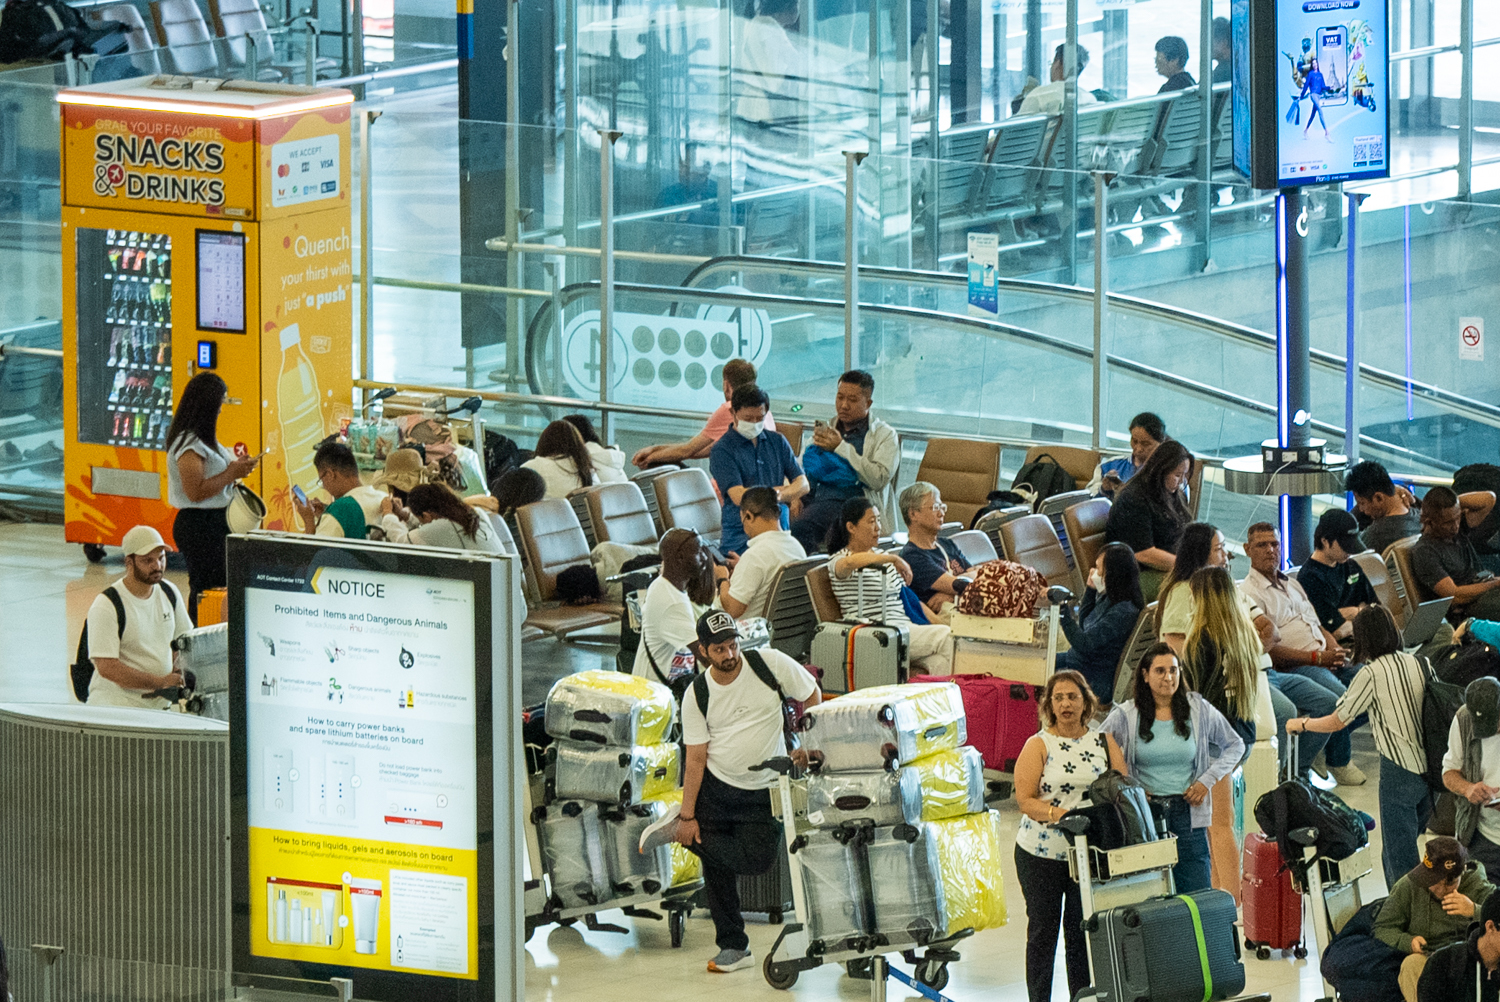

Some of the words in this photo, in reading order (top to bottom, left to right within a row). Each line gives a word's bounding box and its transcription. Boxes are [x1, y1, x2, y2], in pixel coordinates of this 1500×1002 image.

[95, 119, 128, 132] GRAB
[130, 121, 163, 135] YOUR
[164, 125, 222, 140] FAVORITE
[95, 133, 224, 172] SNACKS
[289, 150, 298, 158] WE
[300, 146, 322, 157] ACCEPT
[320, 159, 334, 169] VISA
[94, 164, 115, 196] &
[127, 173, 224, 204] DRINKS
[294, 226, 350, 258] Quench
[281, 272, 303, 291] your
[306, 264, 328, 282] thirst
[330, 259, 350, 277] with
[284, 296, 301, 316] just
[328, 579, 385, 599] NOTICE
[274, 604, 319, 617] Prohibited
[323, 608, 347, 619] Items
[348, 611, 365, 621] and
[366, 613, 412, 626] Dangerous
[414, 618, 448, 630] Animals
[289, 725, 303, 733] and
[305, 728, 327, 736] spare
[328, 728, 353, 738] lithium
[355, 731, 388, 742] batteries
[401, 737, 424, 745] board
[307, 716, 325, 725] How
[336, 721, 355, 730] carry
[357, 723, 381, 731] power
[382, 725, 405, 733] banks
[273, 835, 290, 844] How
[292, 838, 300, 846] to
[301, 839, 321, 849] bring
[322, 841, 349, 852] liquids,
[352, 845, 368, 854] gels
[370, 846, 384, 855] and
[386, 848, 418, 858] aerosols
[431, 853, 453, 862] board
